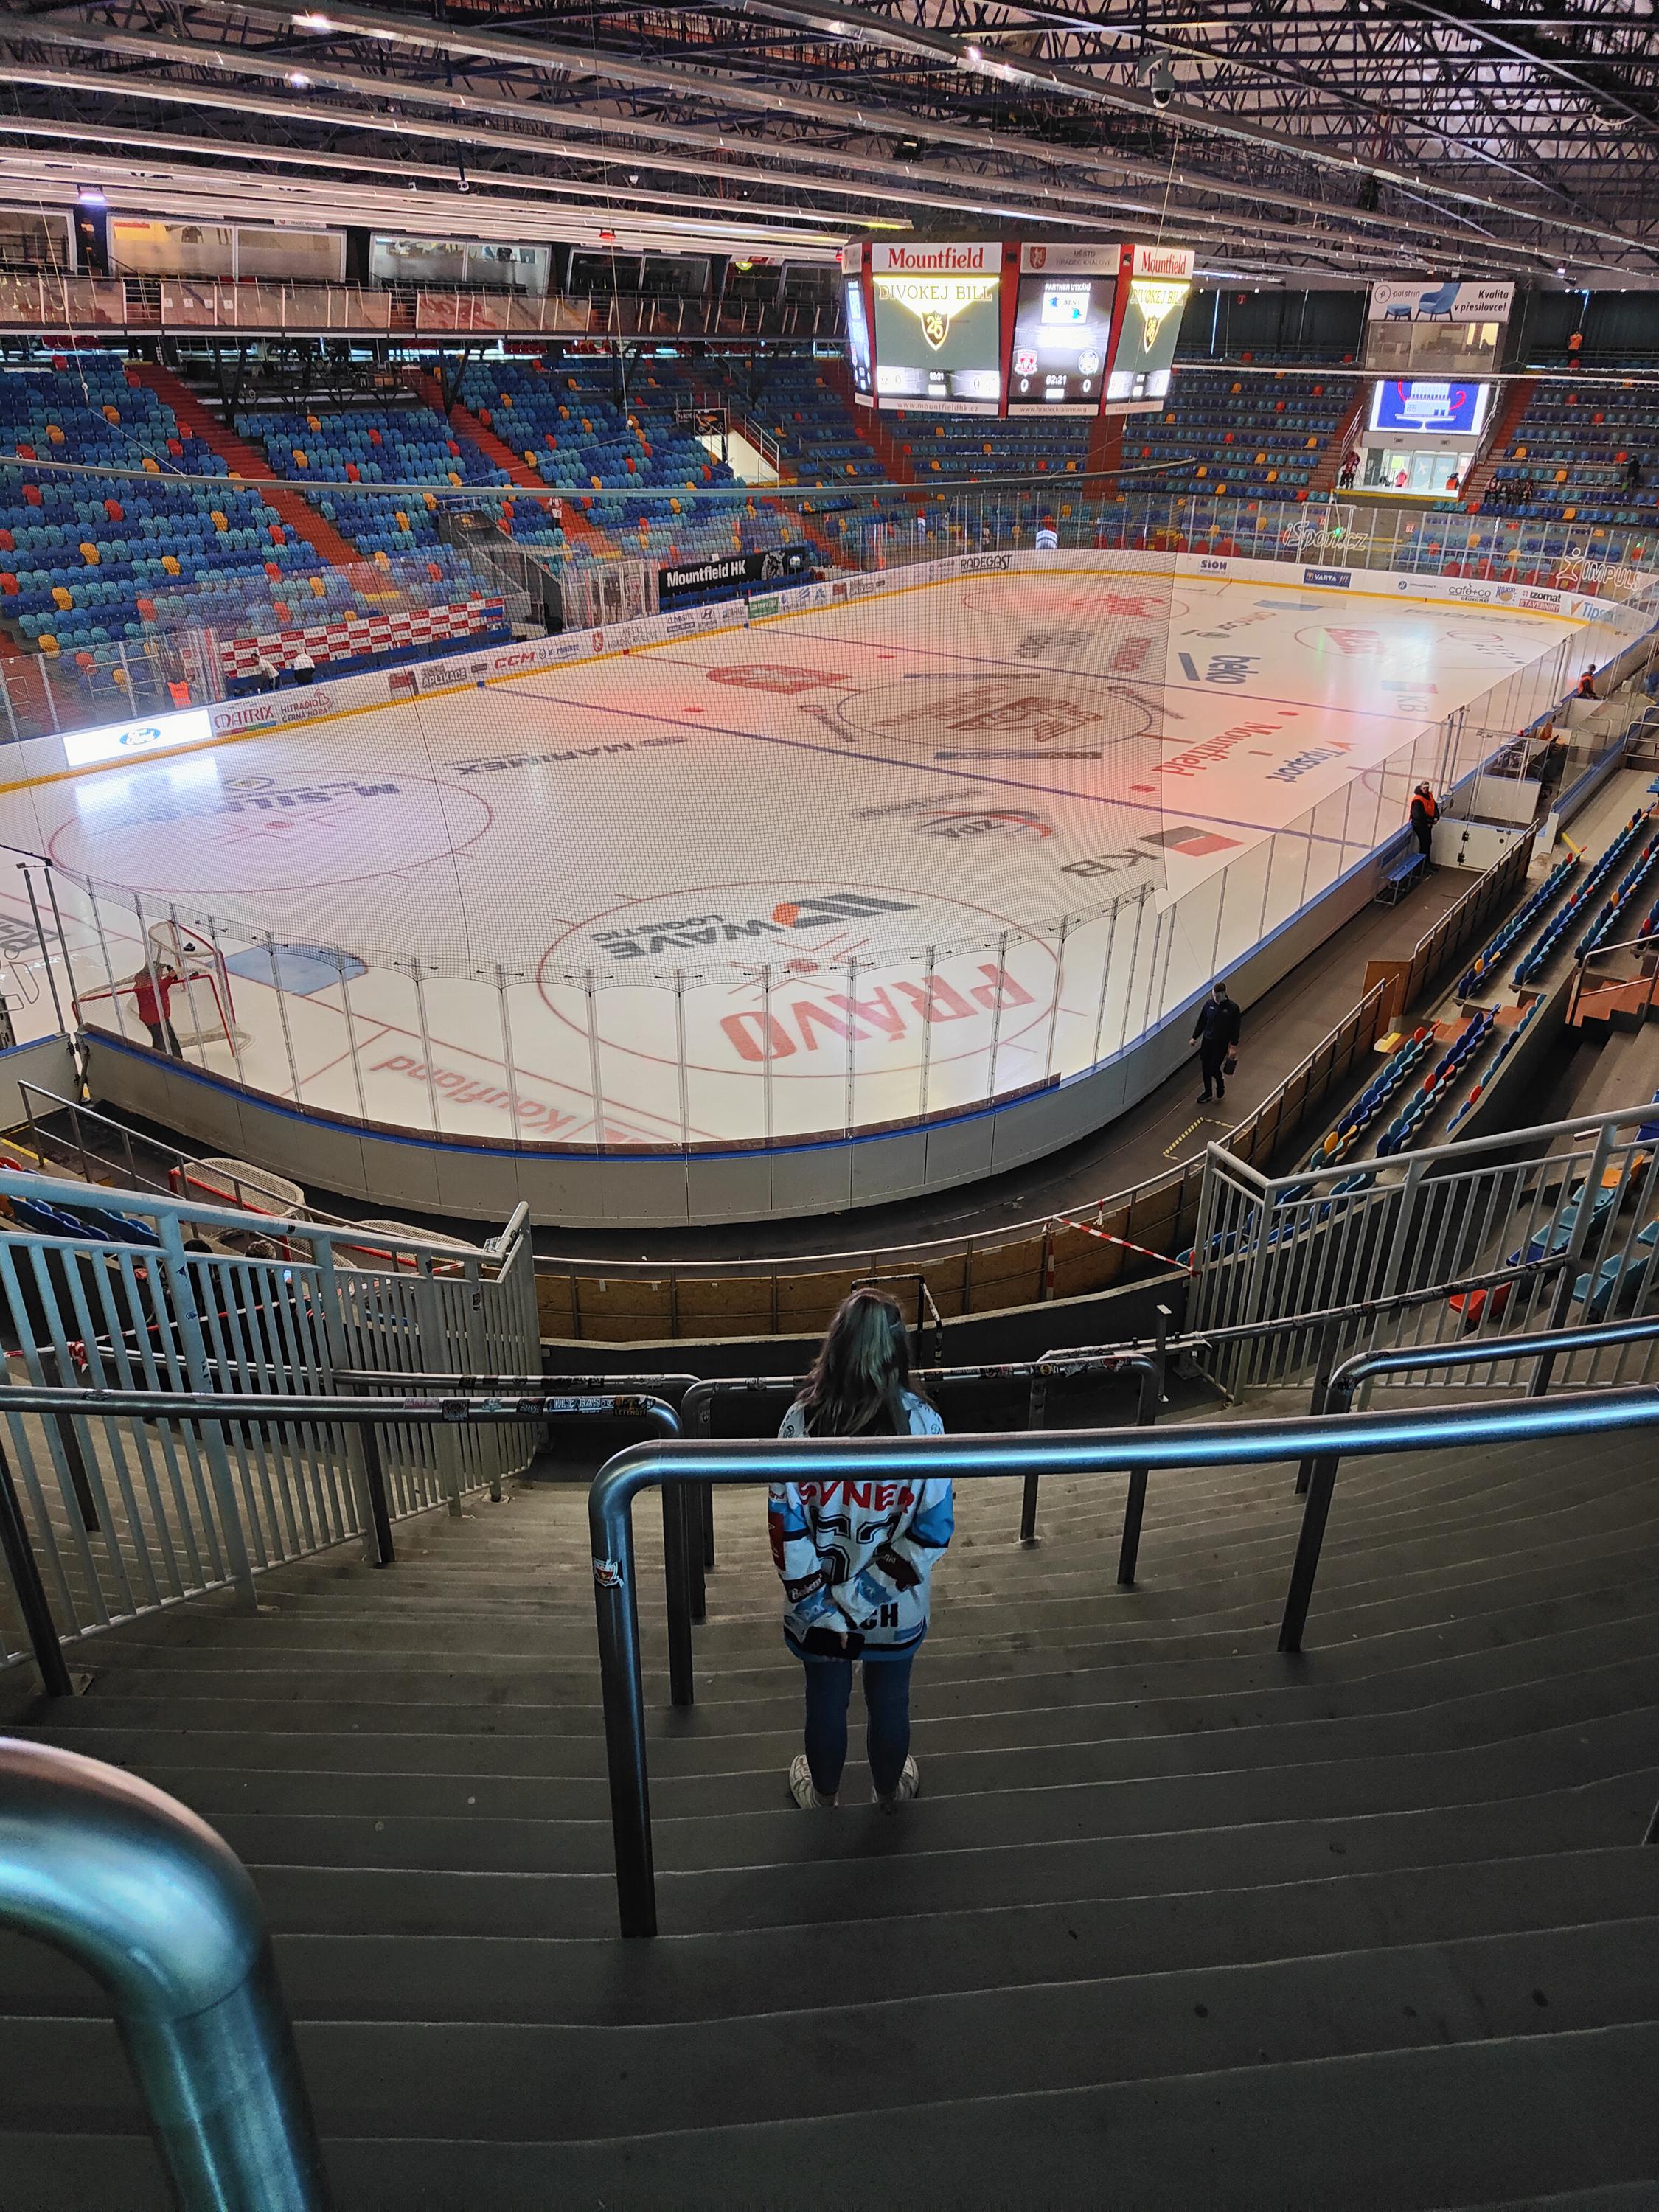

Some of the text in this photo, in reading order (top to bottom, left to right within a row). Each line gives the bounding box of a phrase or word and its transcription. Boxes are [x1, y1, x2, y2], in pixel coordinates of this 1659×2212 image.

[888, 247, 984, 268] Mountfield
[1141, 251, 1186, 274] Mountfield
[879, 285, 992, 301] DIVOKEJ BILL
[1478, 289, 1509, 299] Kvalita
[1460, 302, 1507, 313] přesilovce!
[1020, 378, 1029, 393] 0
[1082, 378, 1091, 393] 0
[897, 401, 979, 412] www.mountfieldhk.cz
[667, 560, 746, 588] Mountfield HK
[961, 555, 1012, 573] RADEGAST
[1315, 573, 1337, 582] VARTA
[1581, 561, 1642, 591] IMPULS
[495, 652, 535, 669] CCM
[1206, 655, 1262, 684] beko
[1150, 720, 1283, 776] Mountfield
[1265, 747, 1346, 784] Tipsport
[601, 917, 785, 960] WAVE
[720, 963, 1037, 1062] PRÁVO
[370, 1054, 578, 1134] Kaufland
